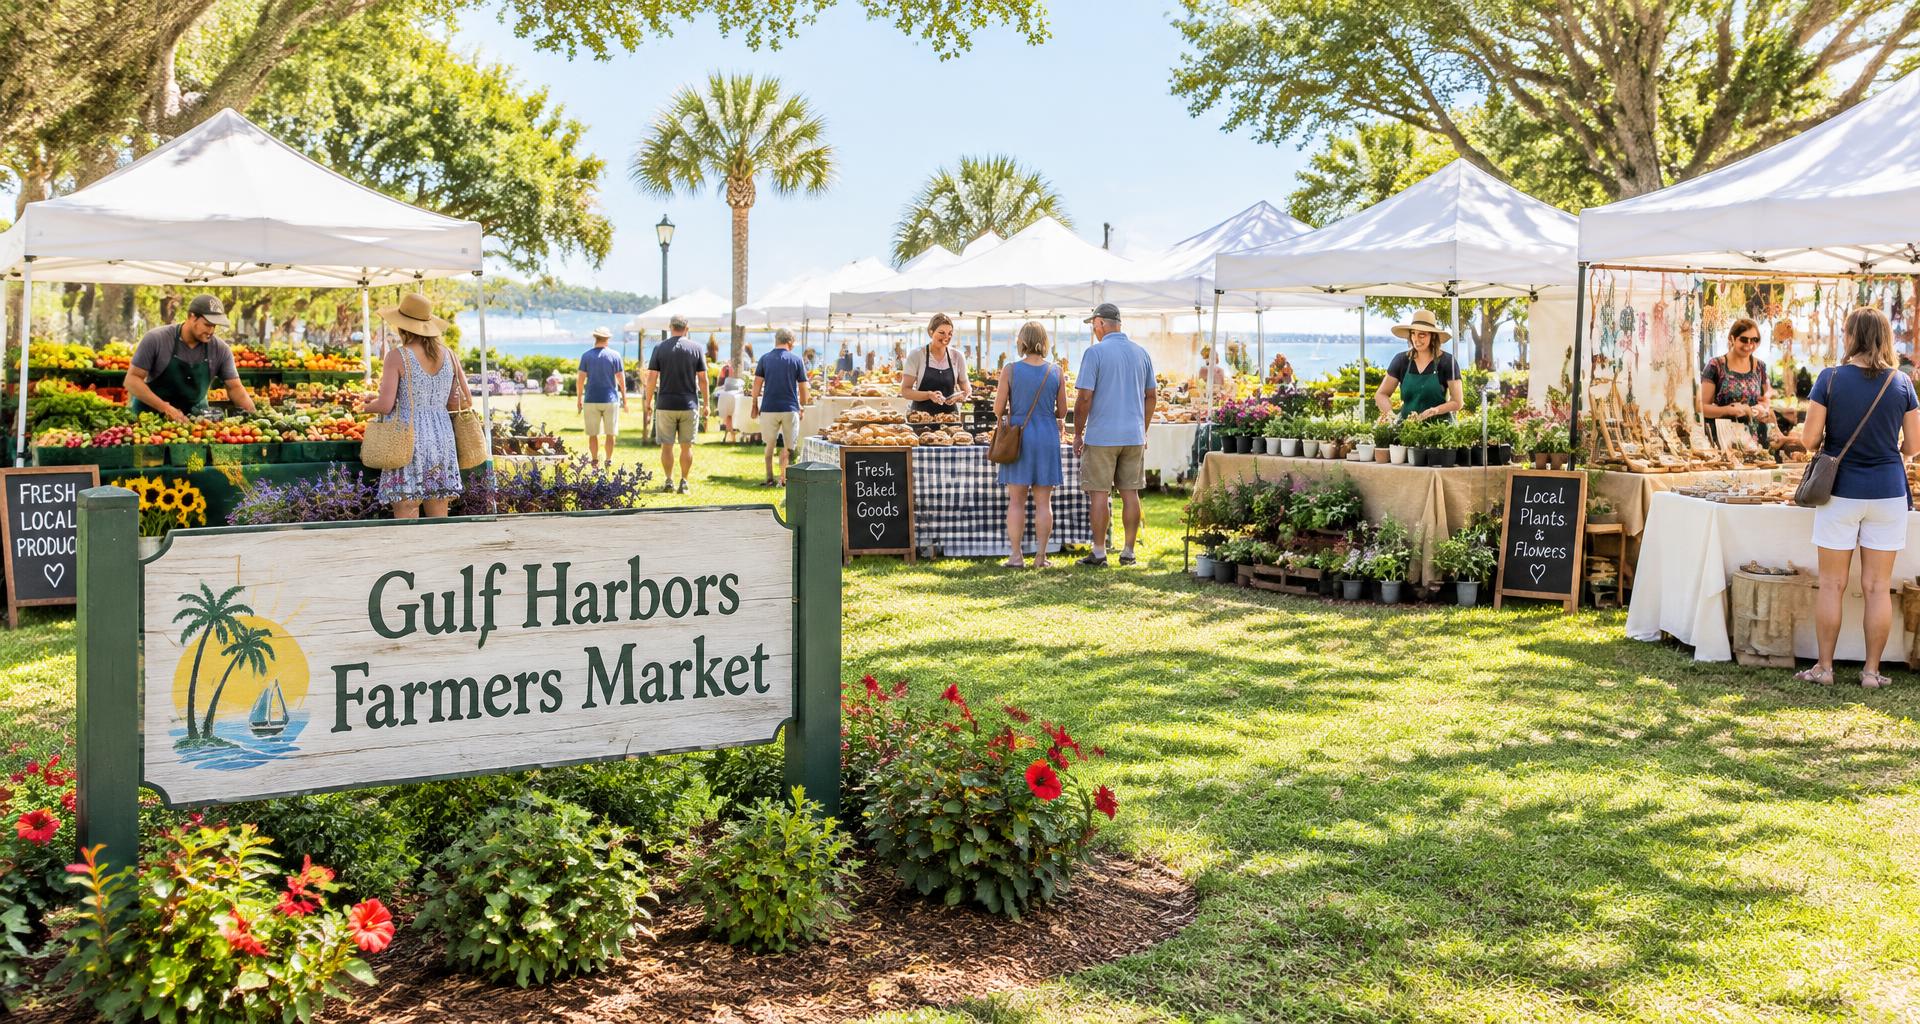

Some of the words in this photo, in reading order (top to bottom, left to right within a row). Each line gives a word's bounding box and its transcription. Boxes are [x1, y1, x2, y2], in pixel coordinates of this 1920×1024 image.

[855, 460, 895, 477] Fresh
[20, 482, 76, 505] FRESH
[855, 481, 897, 498] Baked
[1524, 485, 1565, 504] Local
[856, 501, 899, 518] Goods
[1520, 508, 1565, 526] Plants
[20, 509, 78, 531] LOCAL
[1534, 529, 1545, 541] &
[17, 536, 78, 558] PRODUC
[368, 562, 507, 650] Gulf
[522, 554, 740, 629] Harbors
[330, 661, 563, 734] Farmers
[582, 634, 771, 710] Market
